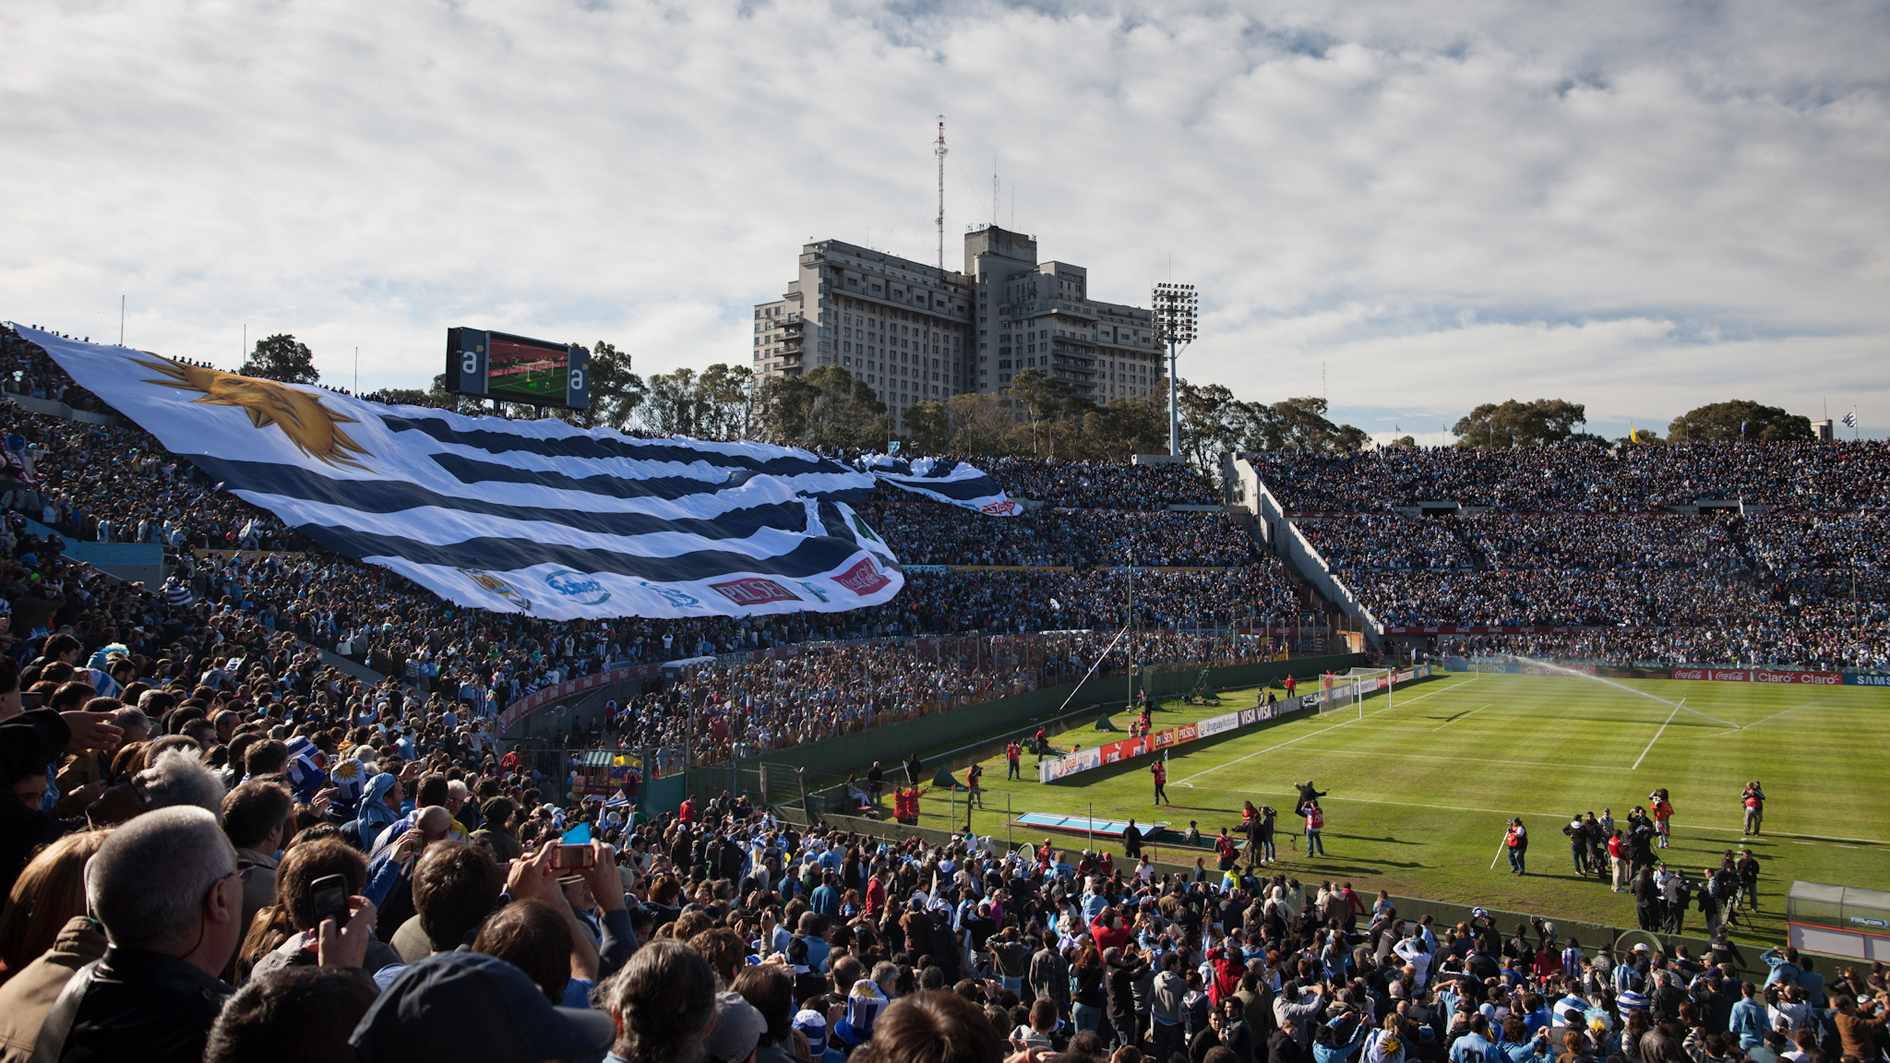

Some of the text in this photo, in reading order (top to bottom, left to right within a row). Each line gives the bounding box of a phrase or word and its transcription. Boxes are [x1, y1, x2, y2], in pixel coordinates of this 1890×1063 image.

[1675, 670, 1702, 680] Coca-Cola
[1715, 671, 1743, 681] Coca-Cola
[1758, 673, 1791, 683] Claro
[1801, 674, 1836, 685] Claro
[1240, 708, 1256, 725] VISA
[1256, 704, 1272, 719] VISA
[1178, 726, 1196, 739] PILSEN
[1156, 732, 1174, 746] PILSEN
[1850, 916, 1883, 927] FIFA.com
[1744, 1012, 1757, 1030] 4
